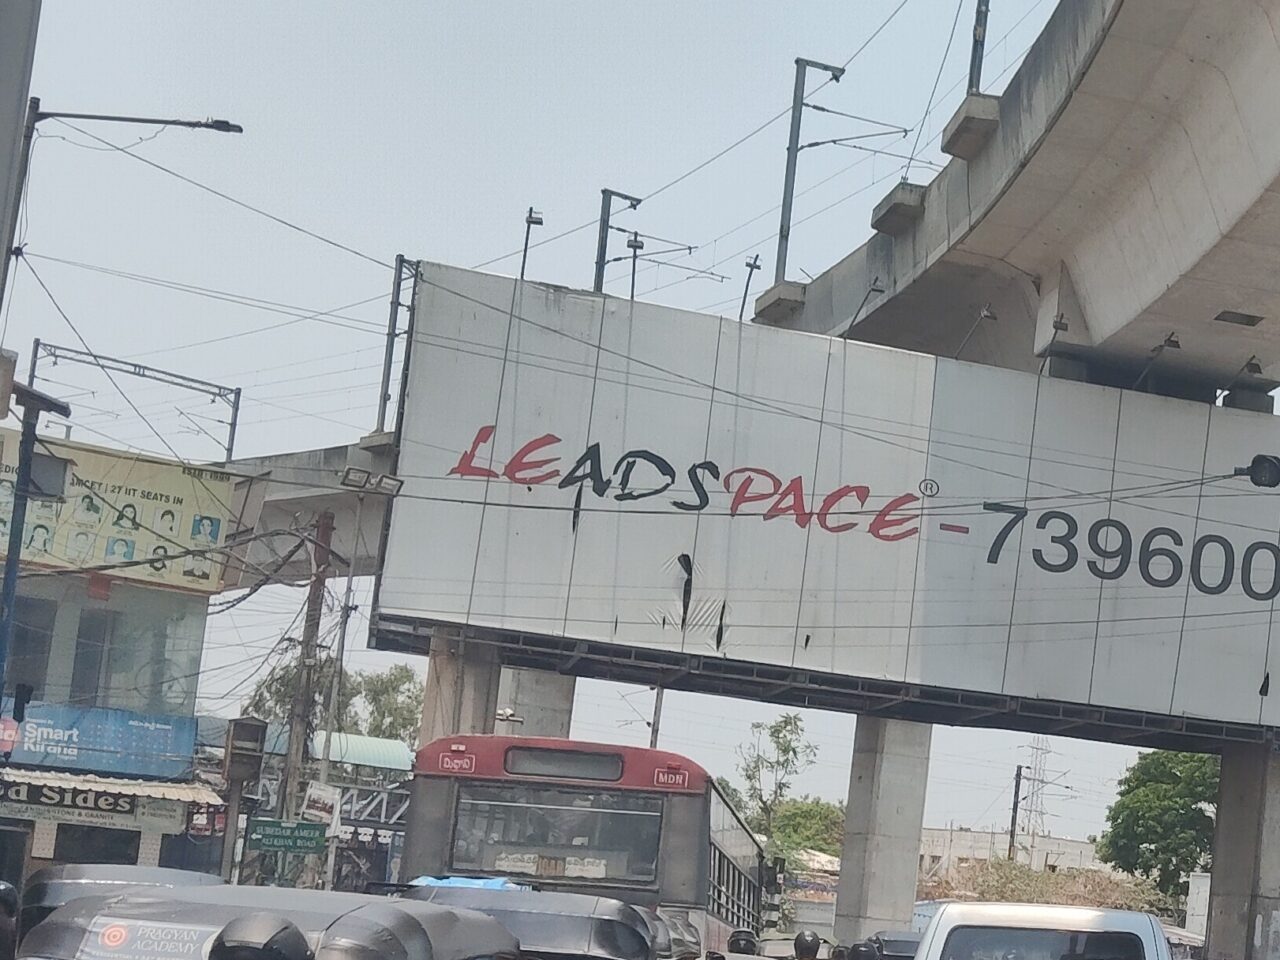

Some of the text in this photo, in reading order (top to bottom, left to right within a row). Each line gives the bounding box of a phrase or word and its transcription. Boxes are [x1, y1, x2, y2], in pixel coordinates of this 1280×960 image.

[110, 485, 122, 495] 27
[124, 486, 139, 498] IIT
[140, 489, 171, 504] SEATS
[172, 495, 183, 506] IN
[24, 723, 79, 742] Smart
[23, 737, 78, 755] Kirana
[658, 772, 683, 785] MDN
[39, 784, 131, 812] Sides
[137, 927, 200, 941] PRAGYAN
[132, 939, 200, 954] ACADEMY
